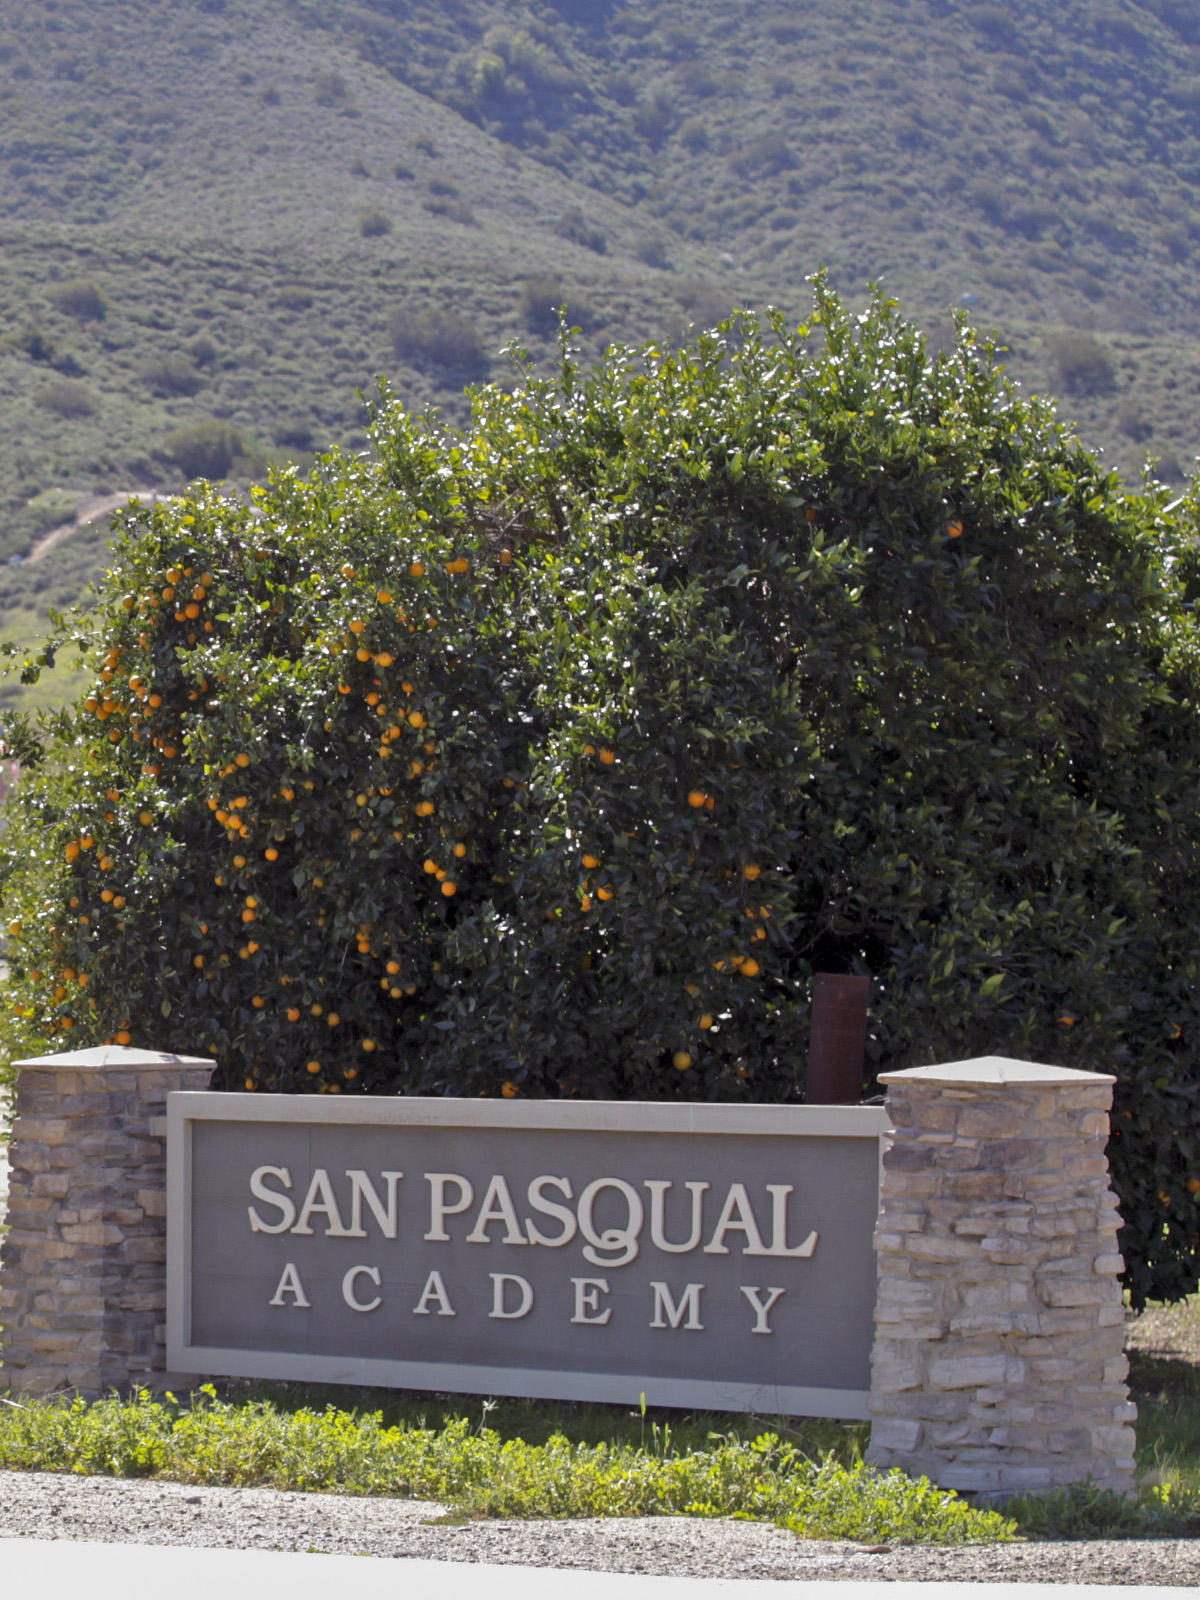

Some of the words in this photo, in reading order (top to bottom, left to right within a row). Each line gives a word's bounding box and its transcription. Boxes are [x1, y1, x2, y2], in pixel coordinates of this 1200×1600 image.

[248, 1165, 403, 1239] SAN
[424, 1172, 818, 1267] PASQUAL
[269, 1263, 785, 1334] ACADEMY
